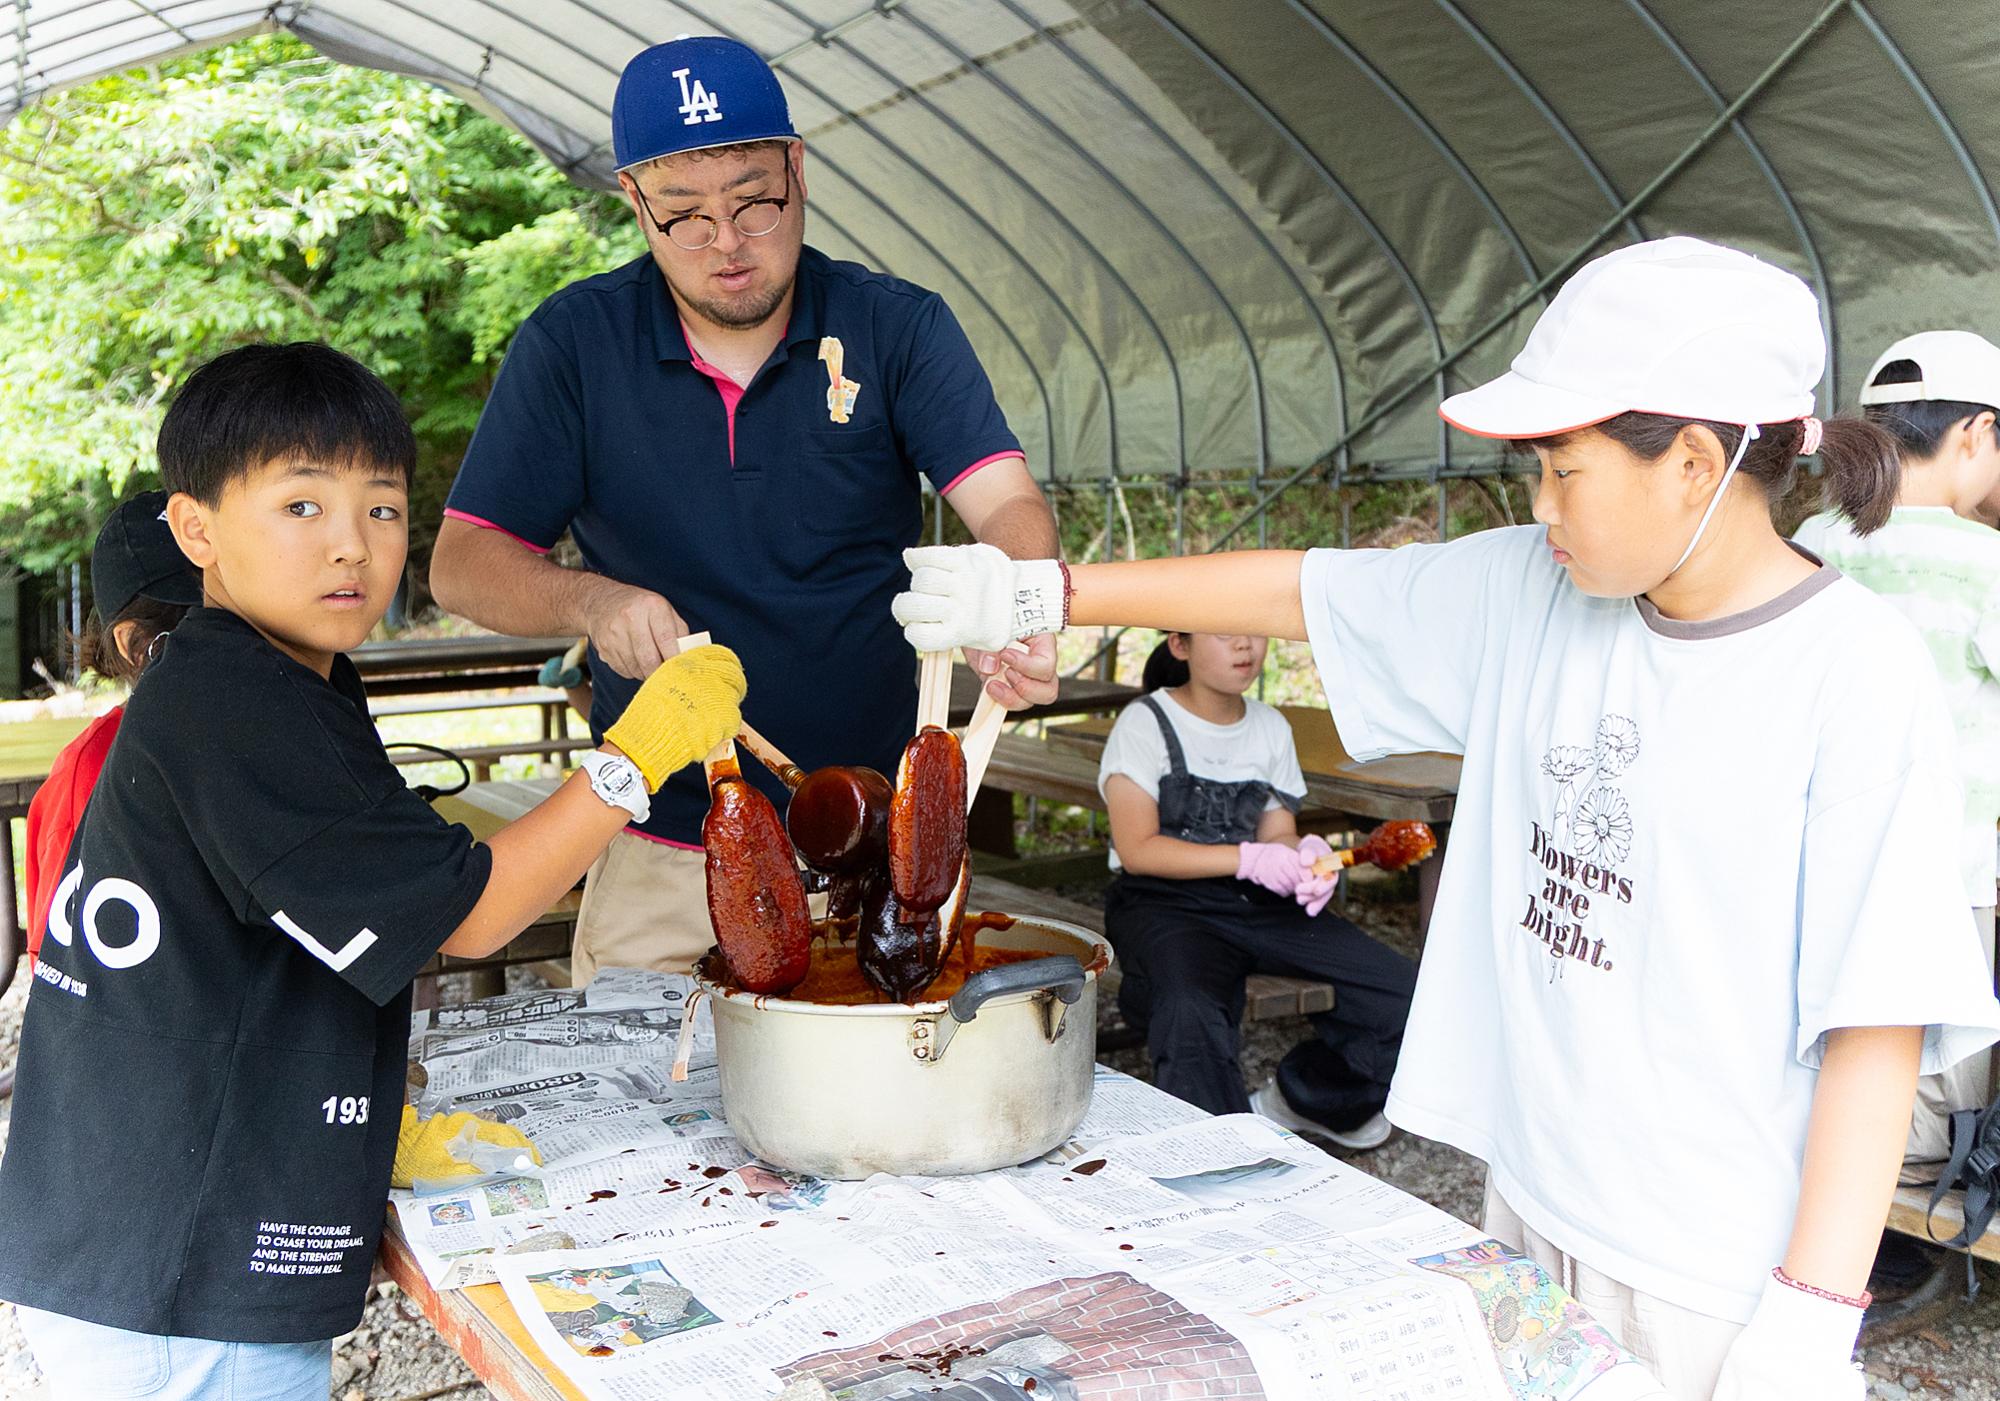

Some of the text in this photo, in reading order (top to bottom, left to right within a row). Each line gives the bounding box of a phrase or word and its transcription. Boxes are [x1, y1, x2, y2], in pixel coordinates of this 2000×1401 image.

[672, 67, 723, 126] LA
[1542, 877, 1590, 919] are
[1519, 894, 1613, 971] bright.
[322, 1096, 371, 1125] 193
[259, 1221, 351, 1236] HAVE THE COURAGE
[256, 1234, 272, 1246] TO
[273, 1236, 305, 1249] CHASE
[306, 1238, 333, 1249] YOUR
[252, 1248, 344, 1262] AND THE STRENGTH
[249, 1260, 266, 1272] TO
[265, 1263, 297, 1275] MAKE
[298, 1265, 322, 1275] THEM
